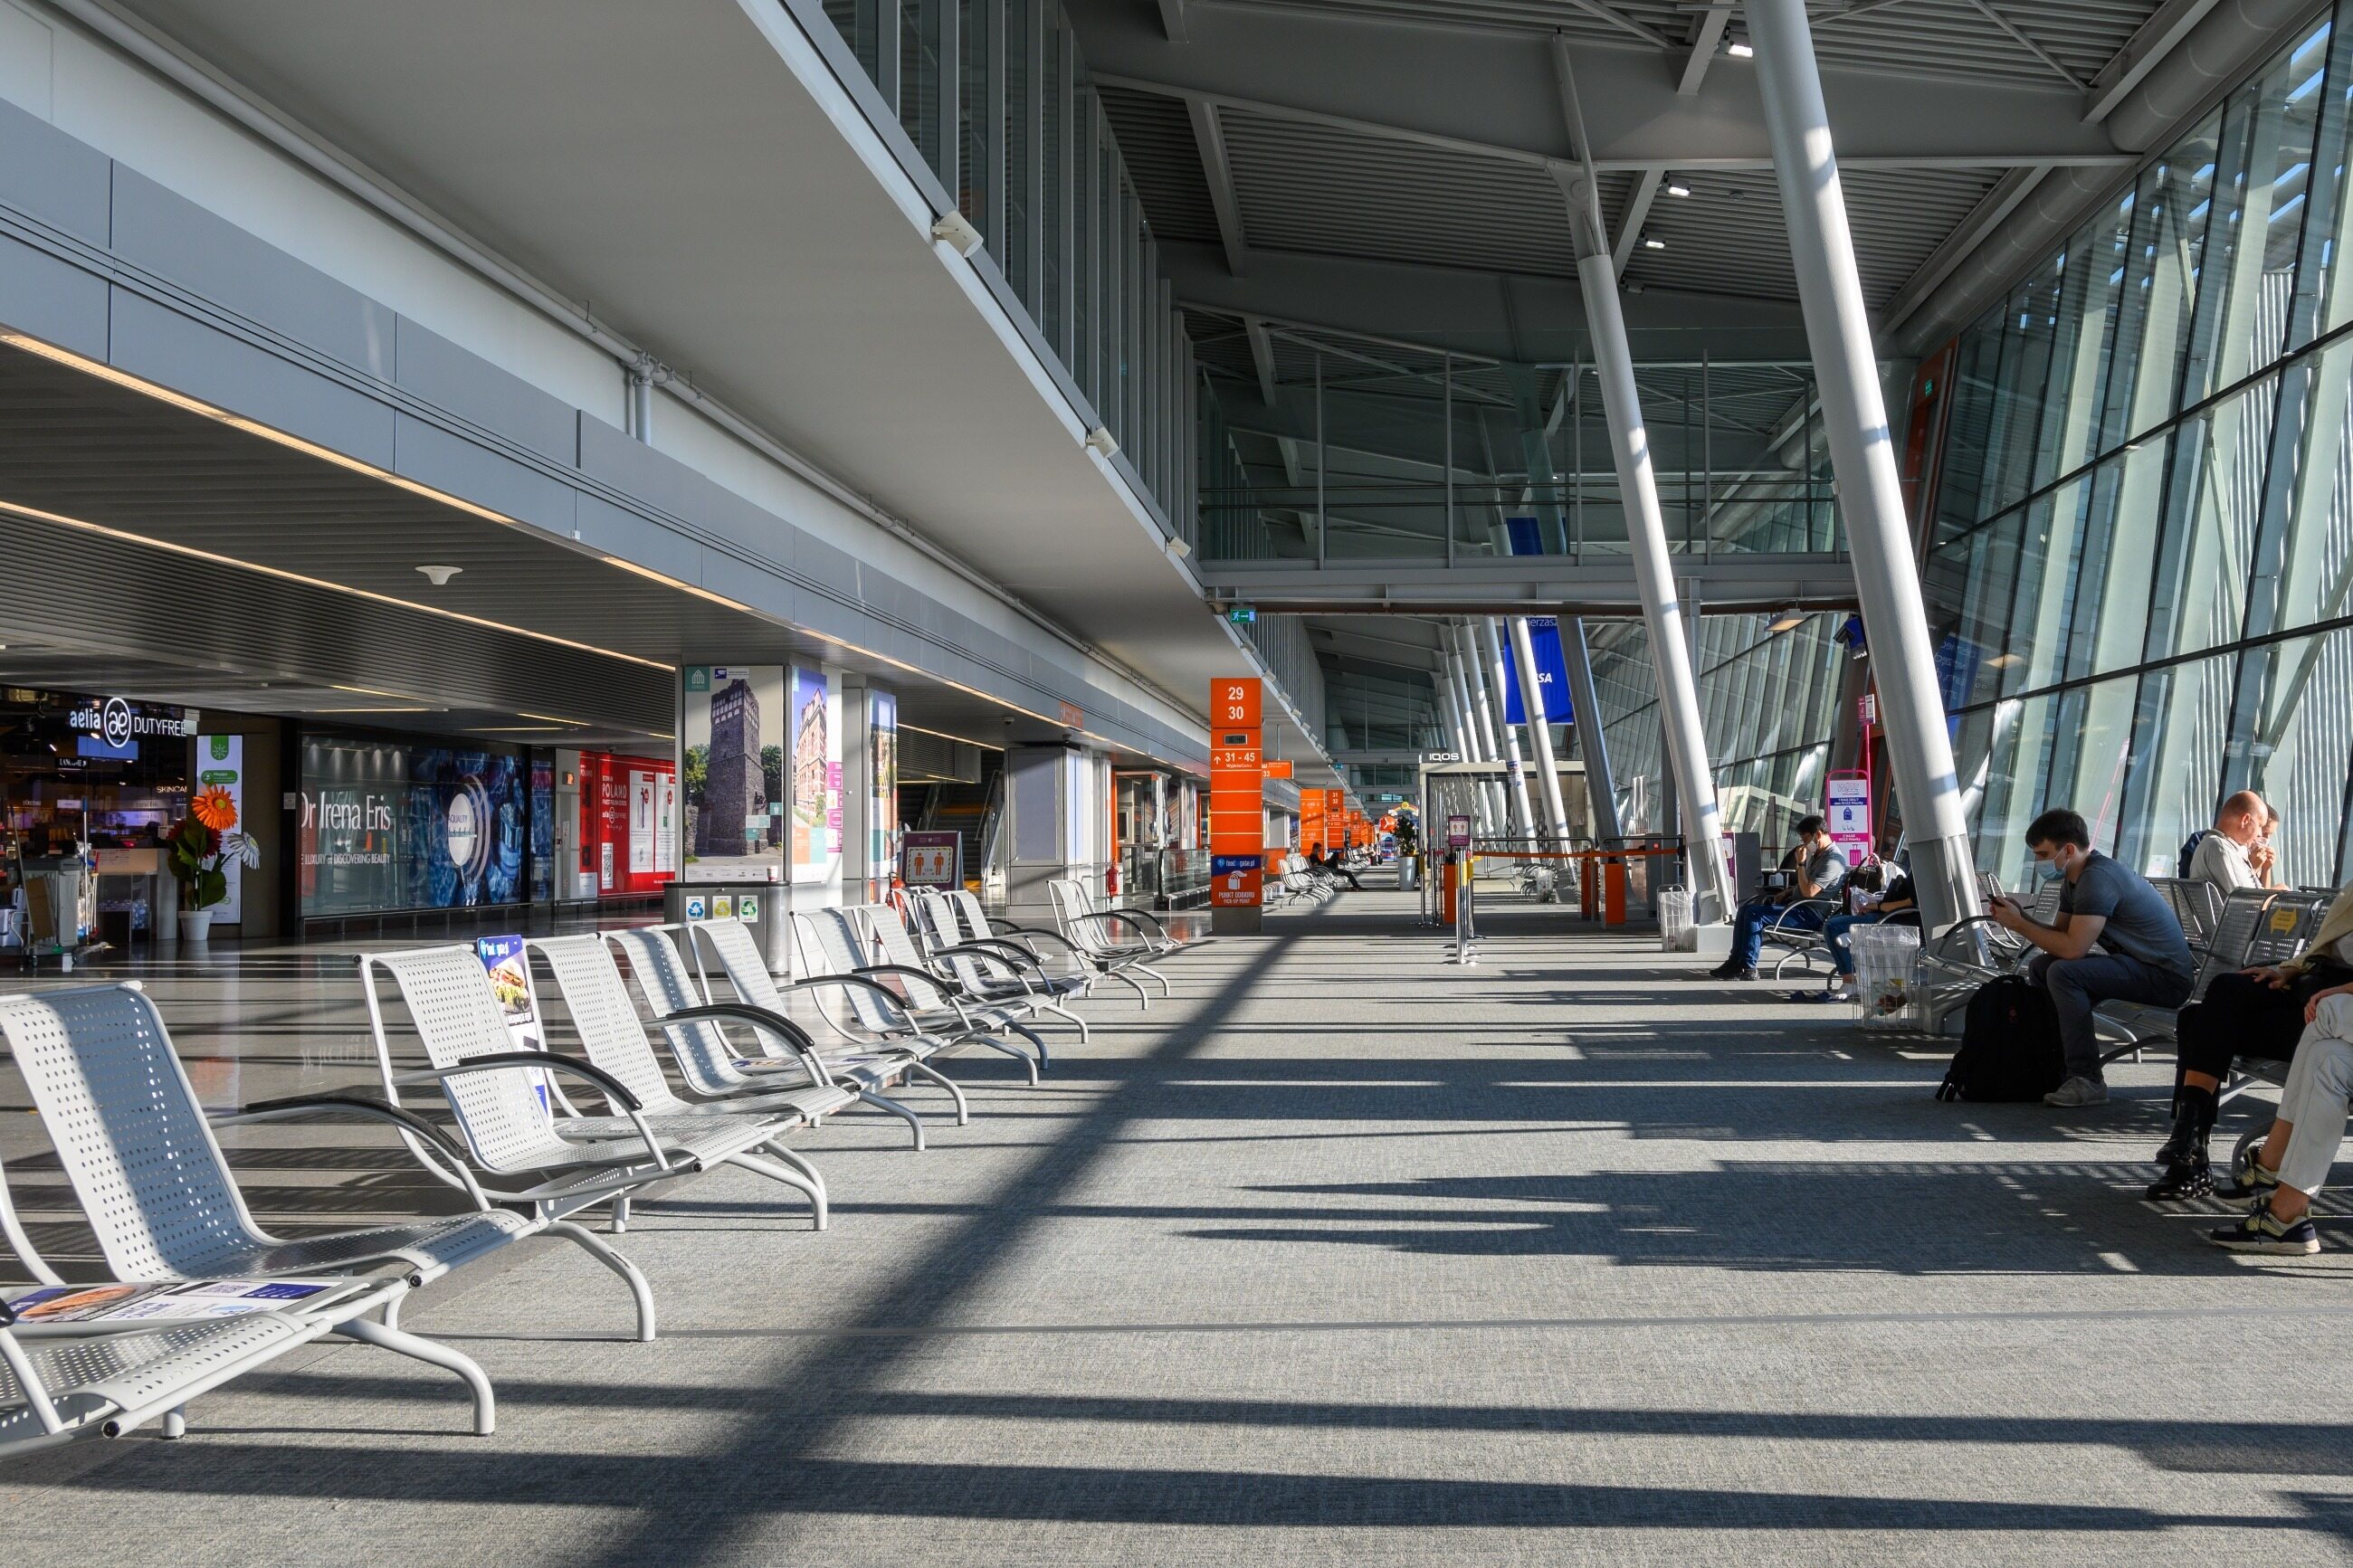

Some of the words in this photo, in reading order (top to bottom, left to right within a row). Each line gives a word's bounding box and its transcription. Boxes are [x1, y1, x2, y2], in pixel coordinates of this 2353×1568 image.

[1227, 686, 1244, 700] 29
[1227, 706, 1244, 720] 30
[1224, 752, 1235, 762] 31
[1243, 752, 1255, 762] 45
[1429, 753, 1460, 762] IQOS
[602, 783, 627, 799] POLAND
[320, 792, 362, 830] Irena
[366, 795, 391, 831] Eris
[305, 853, 326, 864] LUXURY
[333, 853, 370, 864] DISCOVERING
[371, 853, 391, 864] BEAUTY
